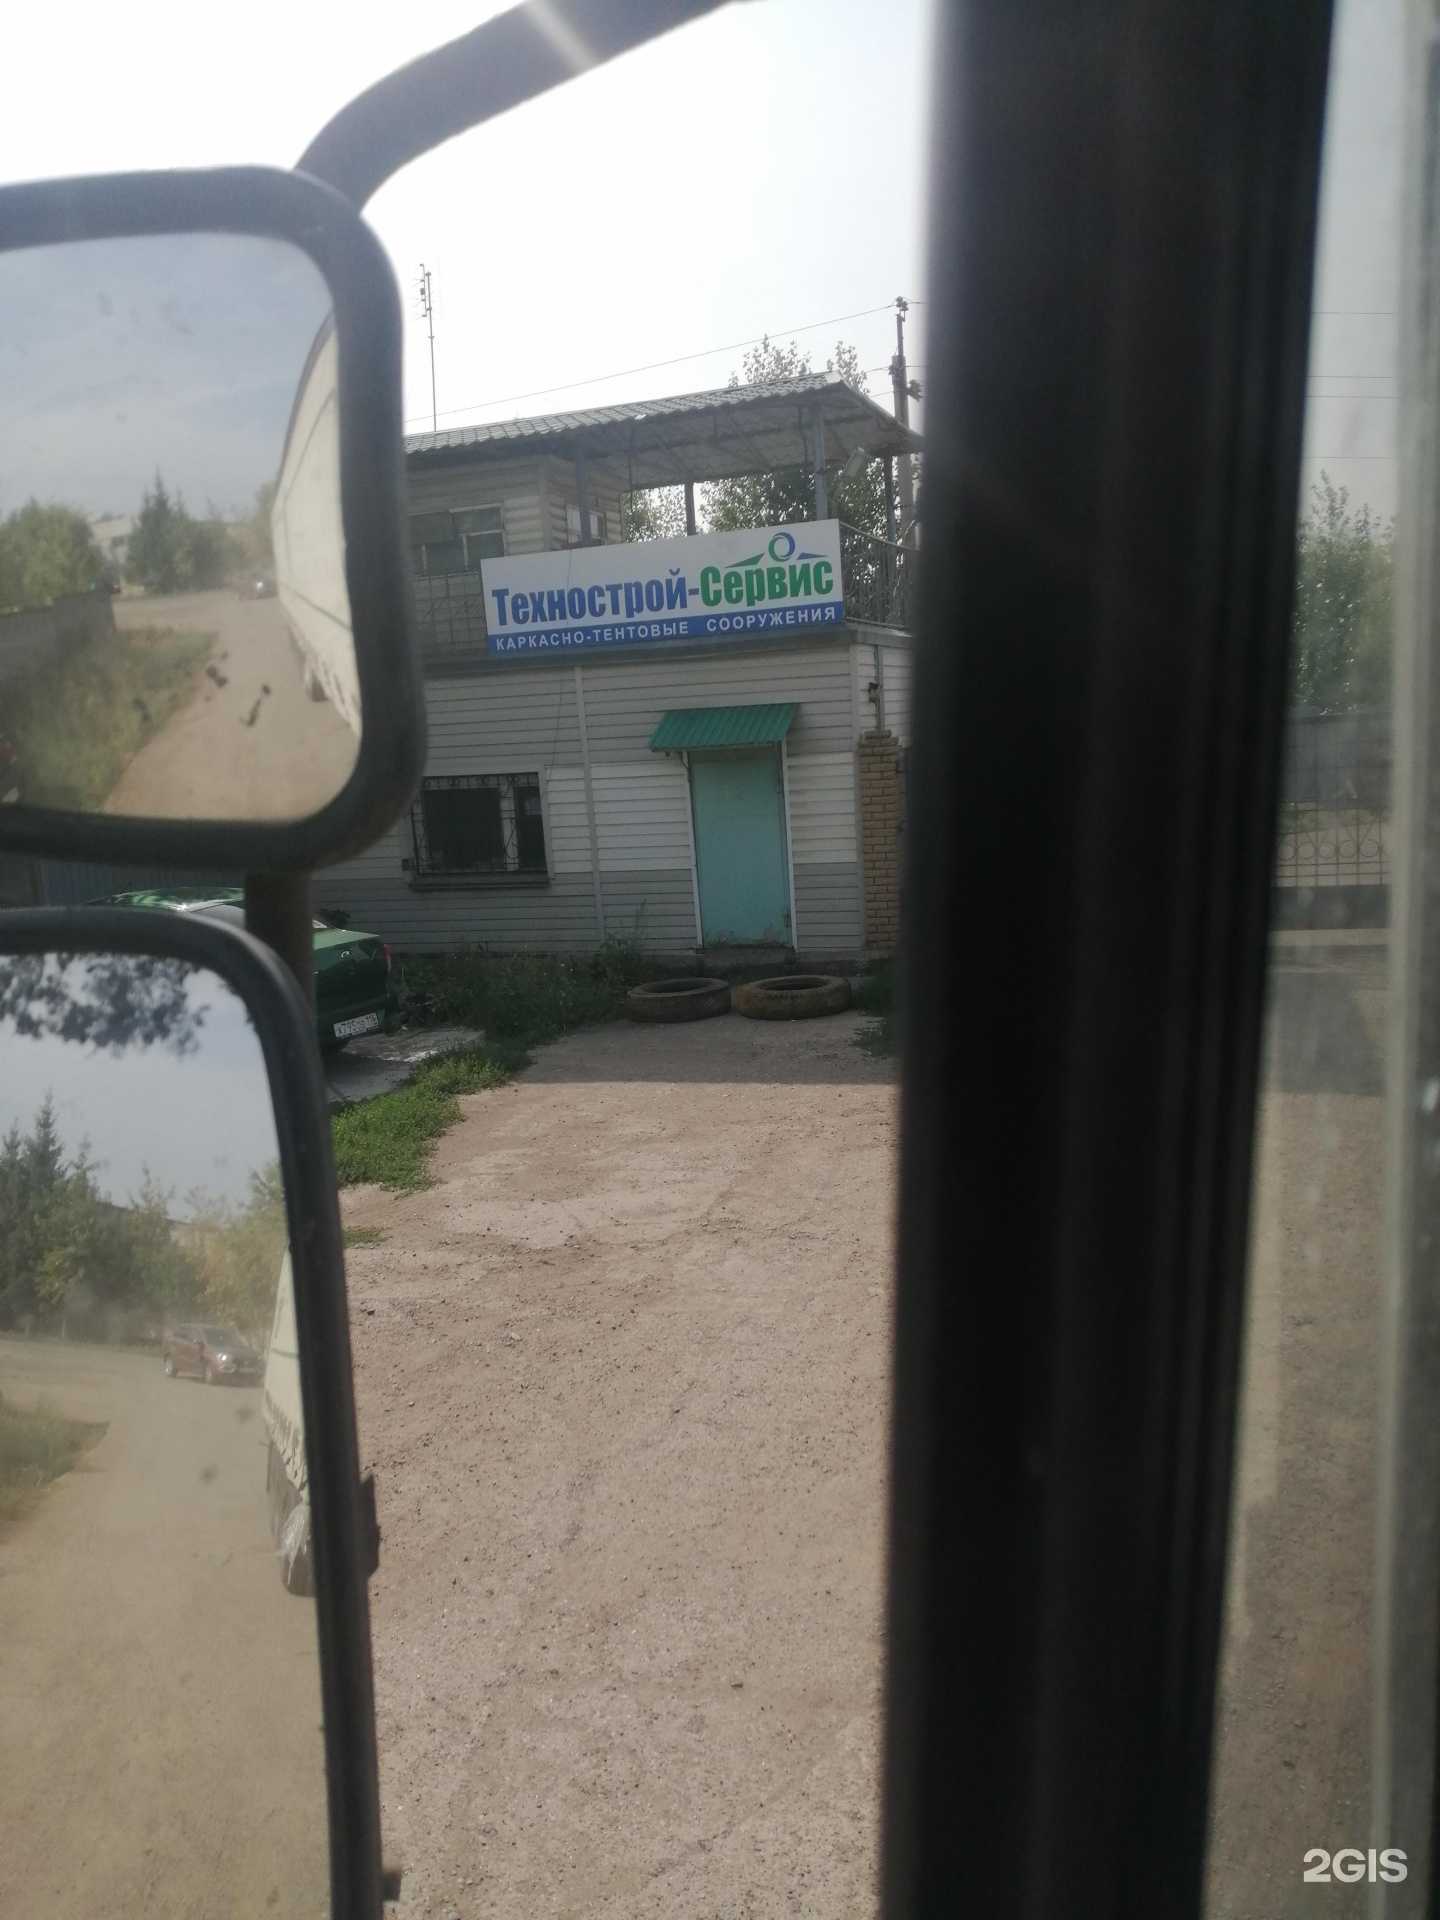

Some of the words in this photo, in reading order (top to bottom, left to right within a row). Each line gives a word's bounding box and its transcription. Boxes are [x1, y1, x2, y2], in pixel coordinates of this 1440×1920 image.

[491, 560, 834, 626] Технострой-Сервис
[495, 620, 689, 651] КАРКАСНО-ТЕНТОВЫЕ
[706, 606, 836, 632] СООРУЖЕНИЯ
